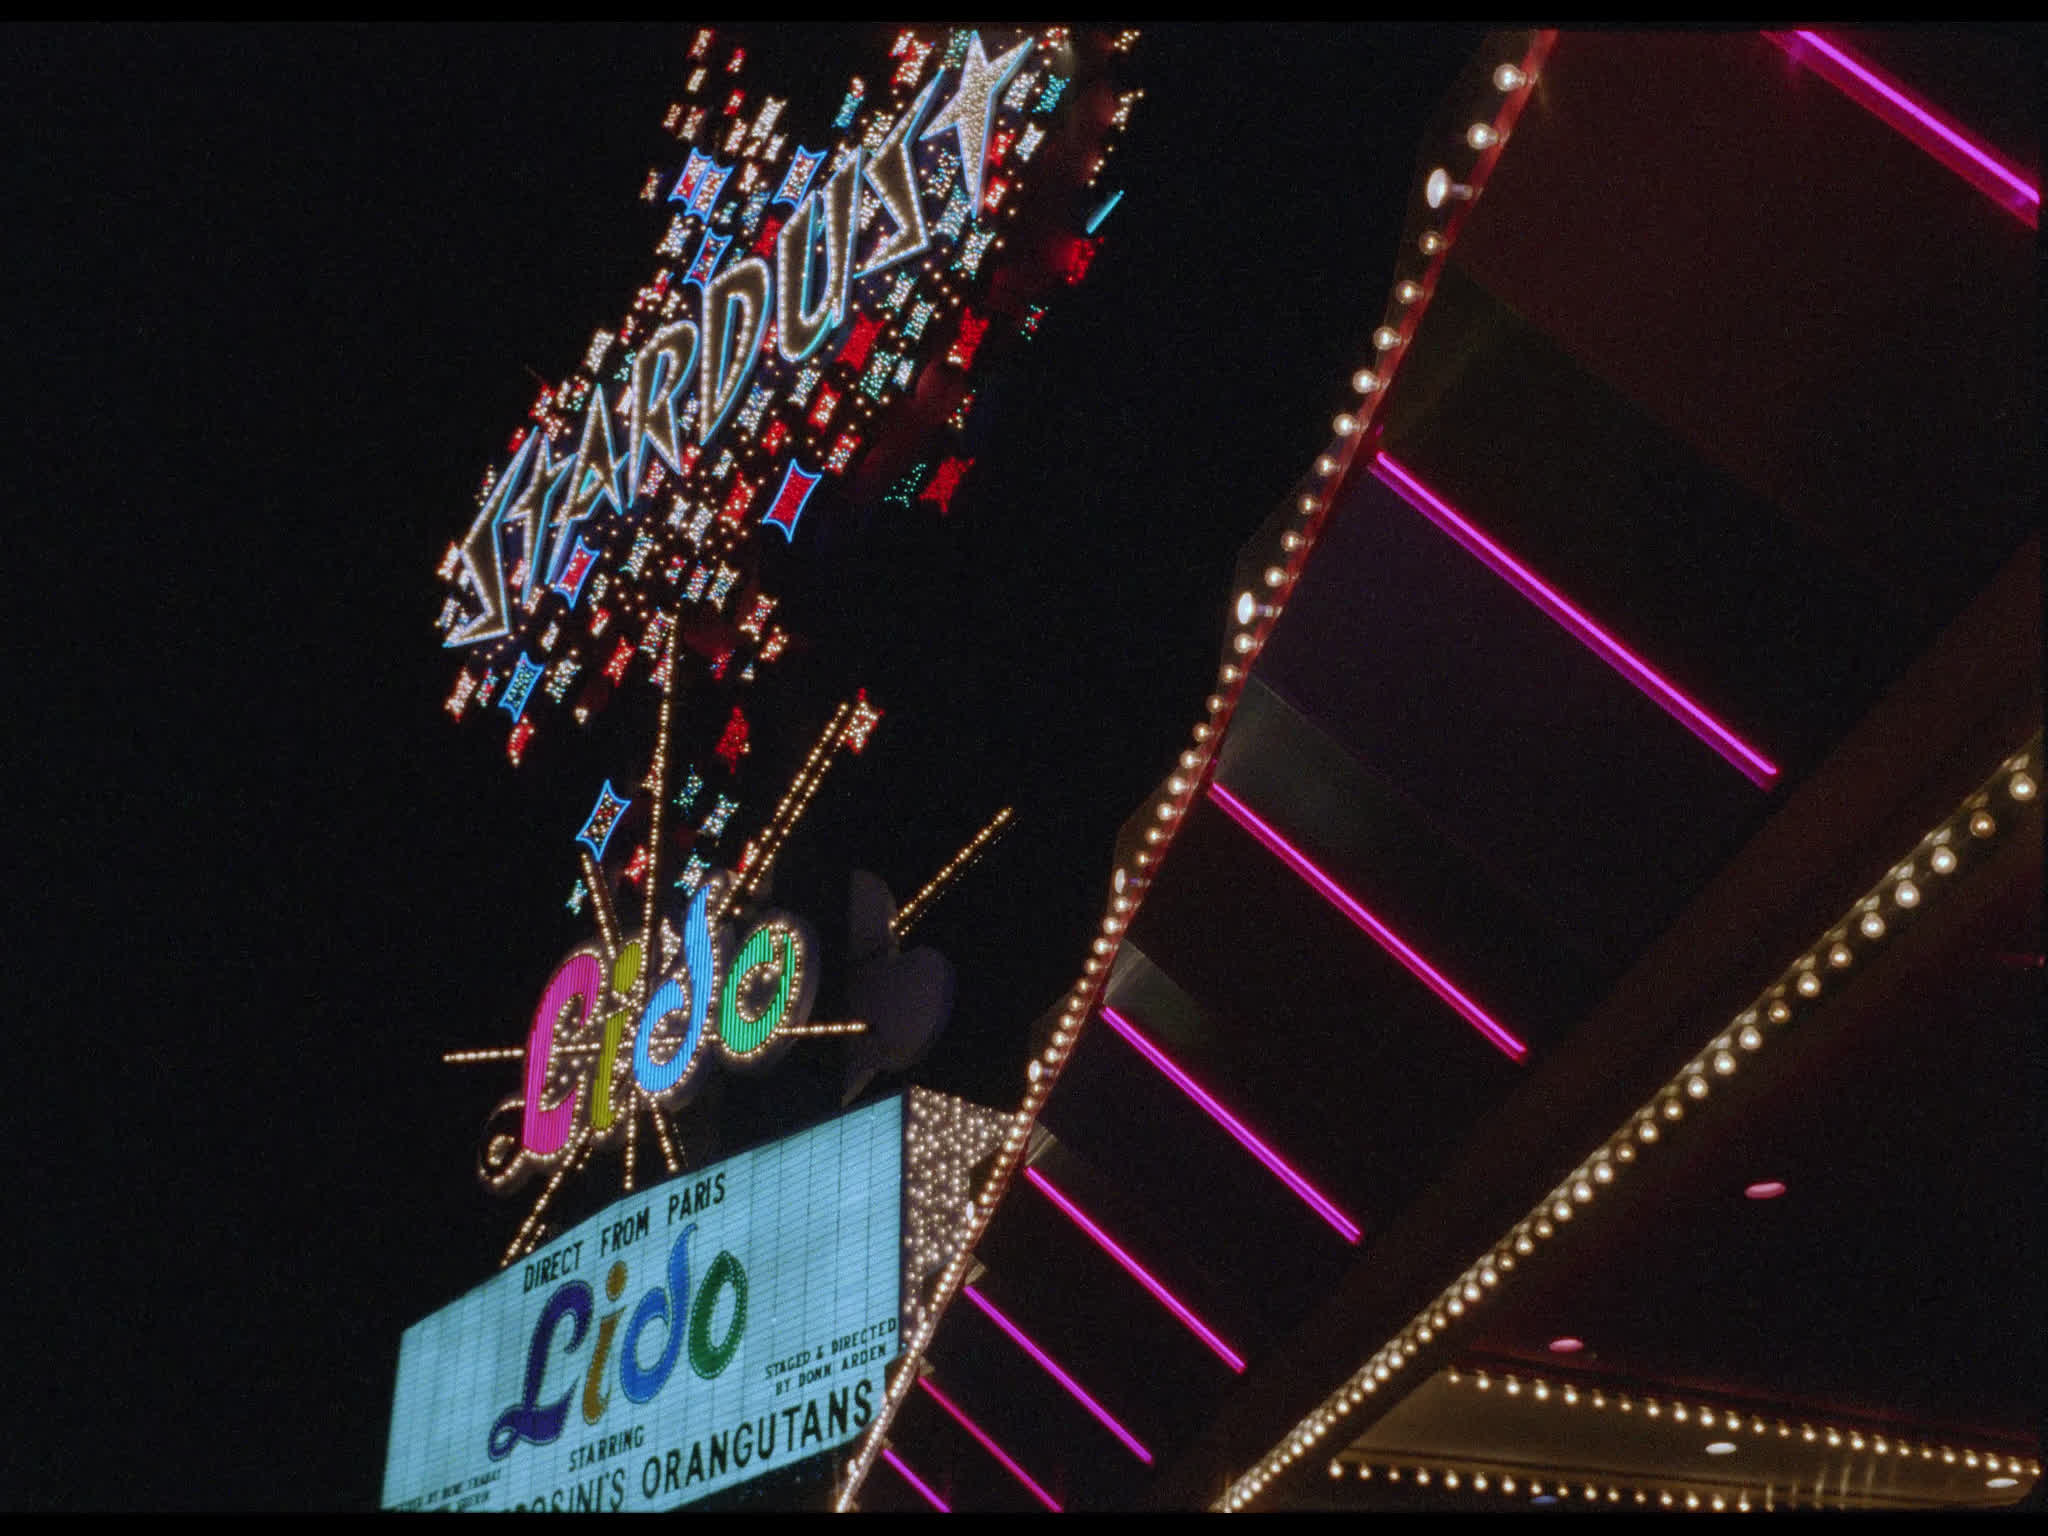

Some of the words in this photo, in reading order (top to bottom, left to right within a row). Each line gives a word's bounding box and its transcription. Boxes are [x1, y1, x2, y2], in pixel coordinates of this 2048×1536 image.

[523, 1240, 585, 1294] DIRECT
[601, 1205, 650, 1257] FROM
[667, 1172, 726, 1225] PARIS
[487, 1222, 749, 1463] Lido
[765, 1350, 811, 1380] STAGED
[831, 1317, 897, 1355] DIRECTED
[775, 1378, 792, 1396] BY
[841, 1342, 887, 1371] ARDEN
[569, 1424, 645, 1473] STARRING
[641, 1378, 873, 1499] ORANGUTANS
